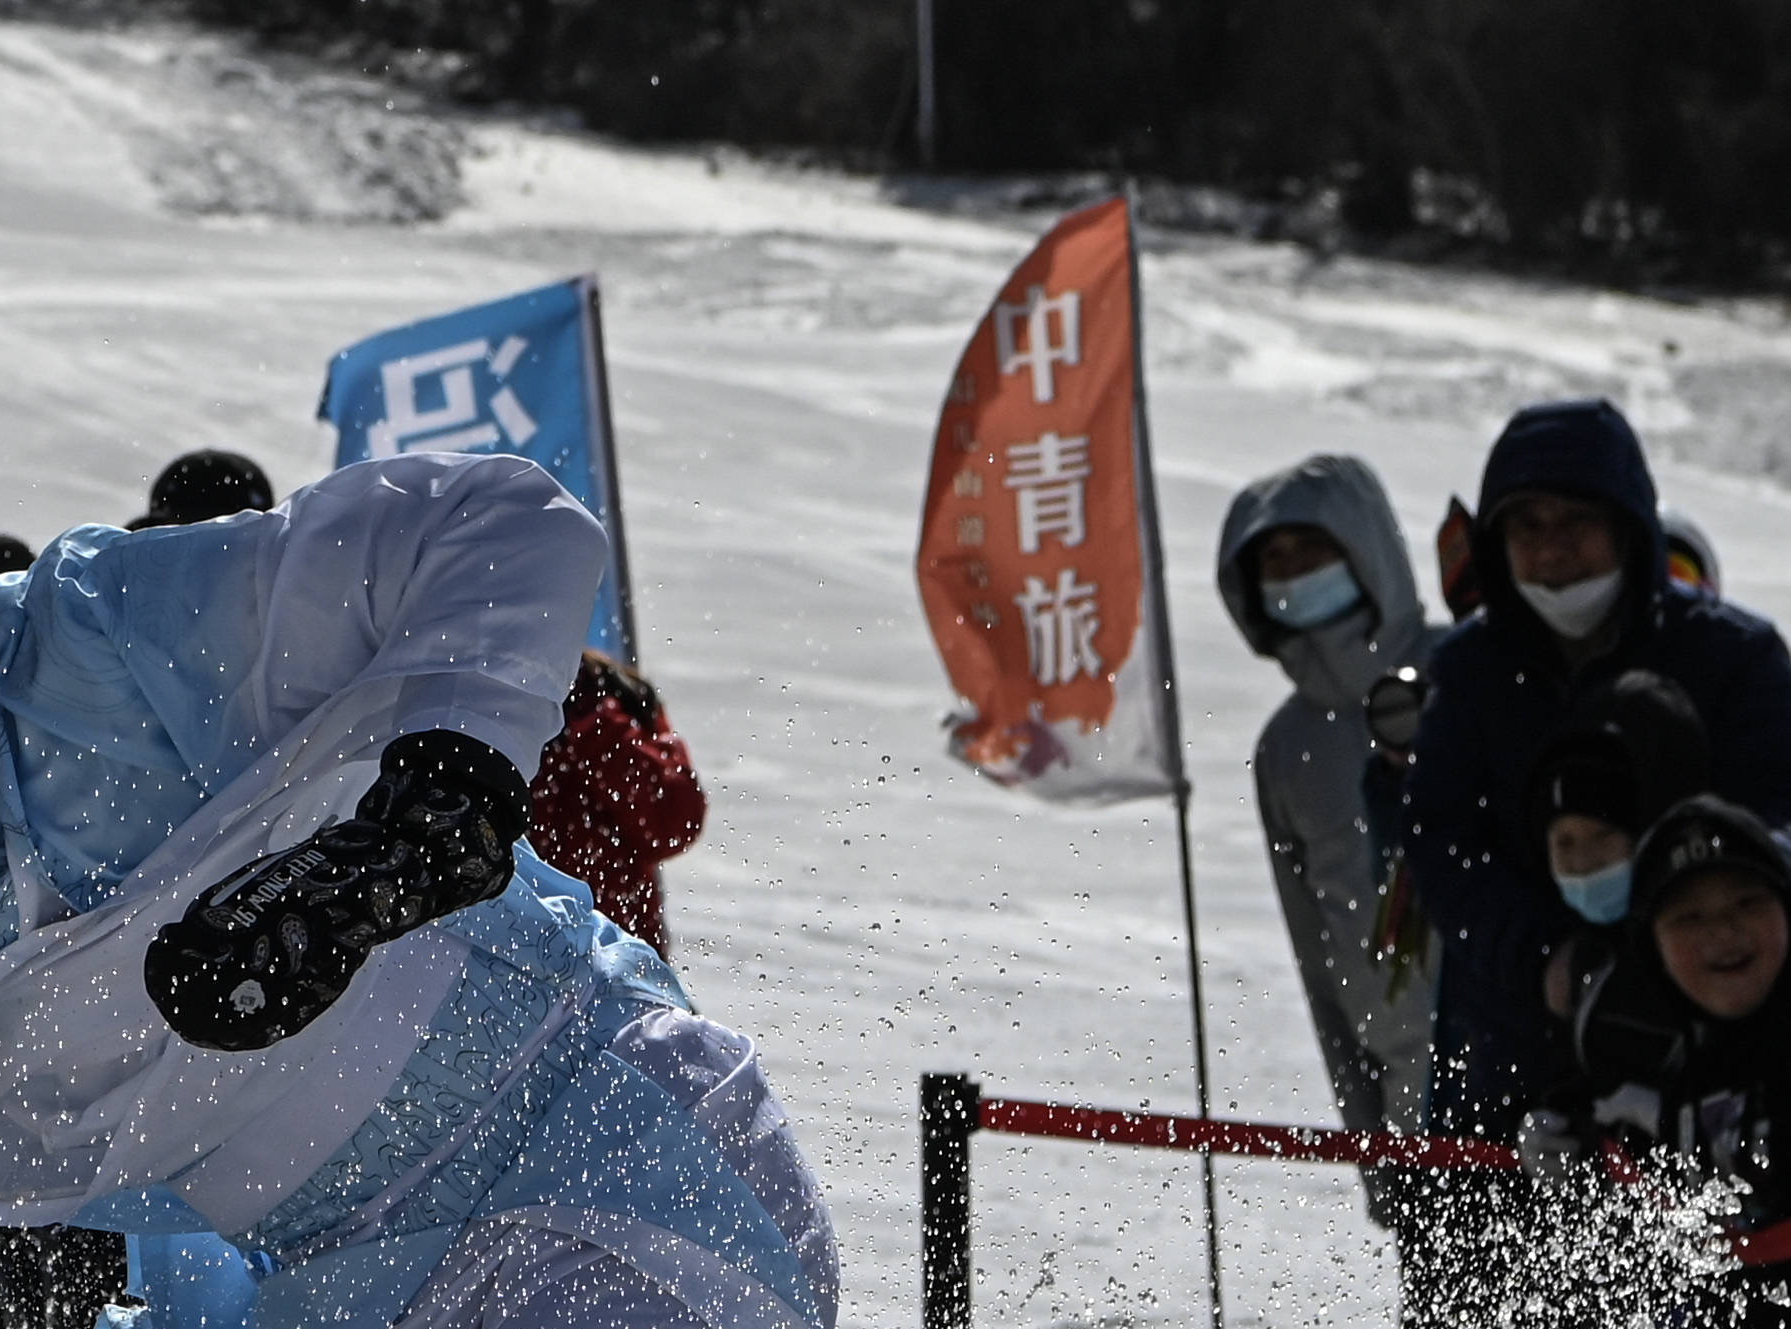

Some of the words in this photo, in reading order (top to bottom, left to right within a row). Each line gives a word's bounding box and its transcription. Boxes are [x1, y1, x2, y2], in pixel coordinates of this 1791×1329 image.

[994, 285, 1103, 686] 中青旅
[285, 849, 327, 878] DEEP
[247, 871, 291, 913] SNOW
